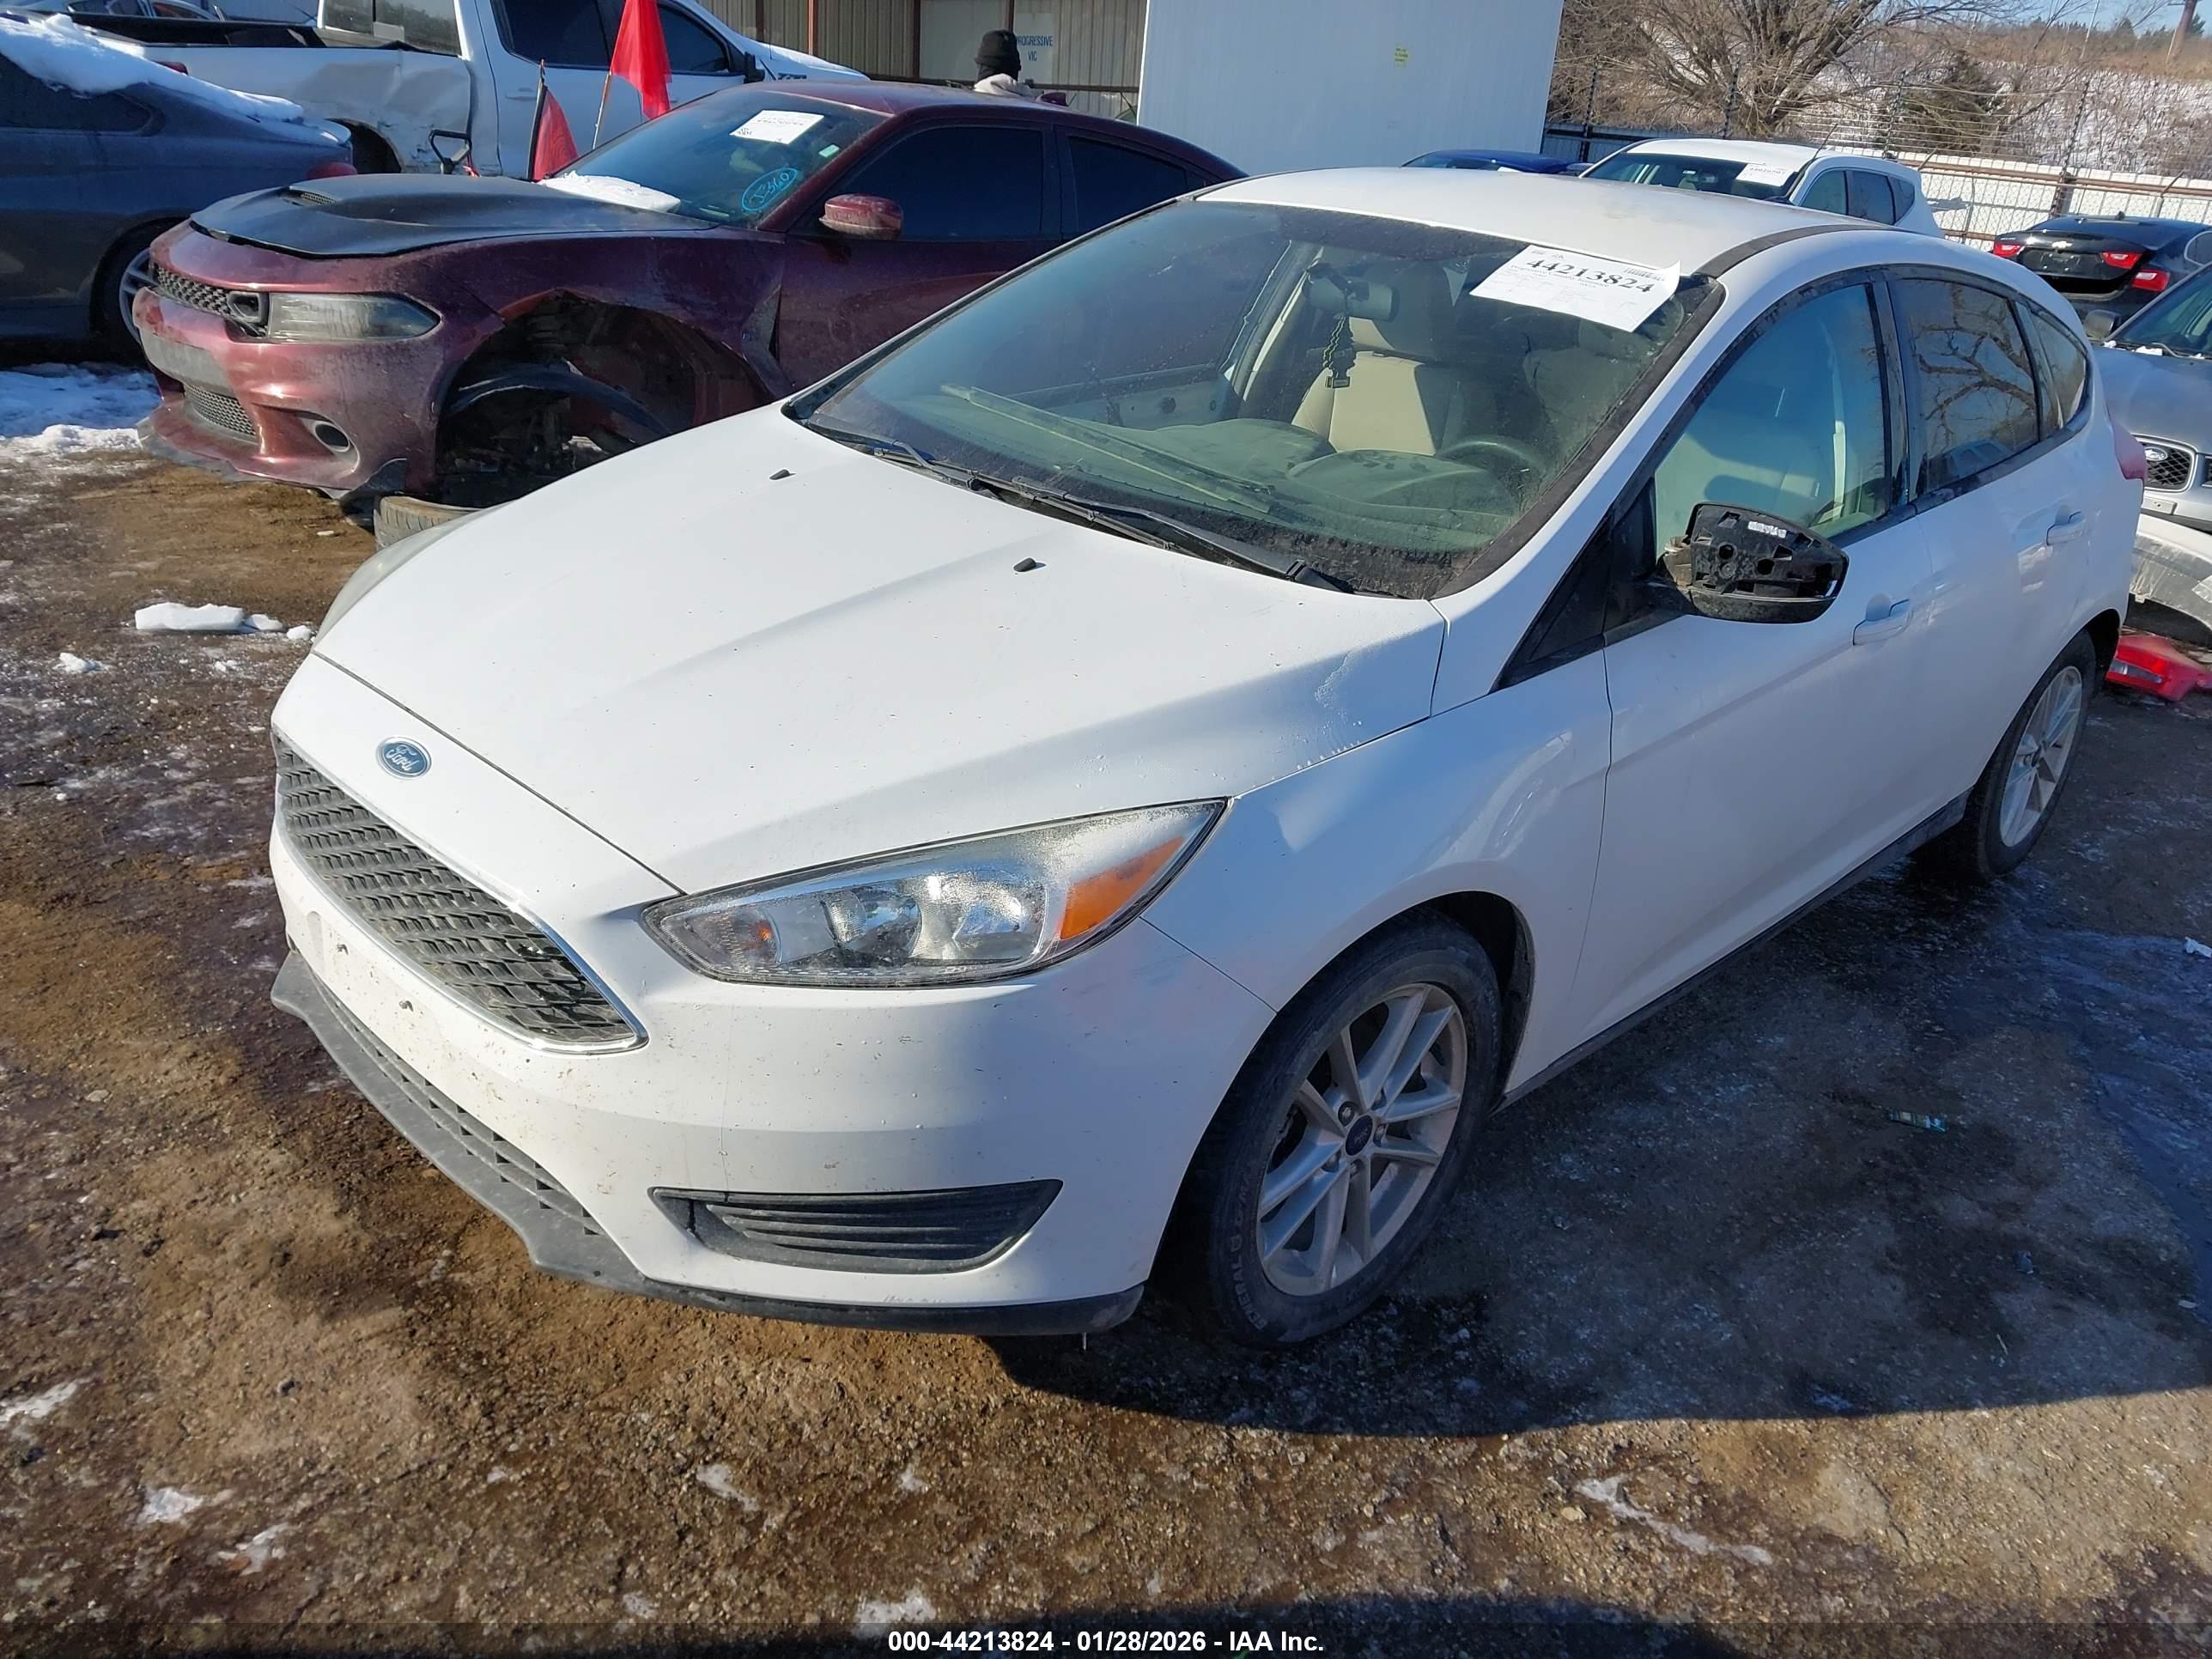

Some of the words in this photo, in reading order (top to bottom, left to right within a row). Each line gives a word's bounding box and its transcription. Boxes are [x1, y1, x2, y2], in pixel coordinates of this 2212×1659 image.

[1028, 51, 1037, 62] VIC
[1526, 259, 1655, 293] 44213824
[386, 744, 420, 771] Ford
